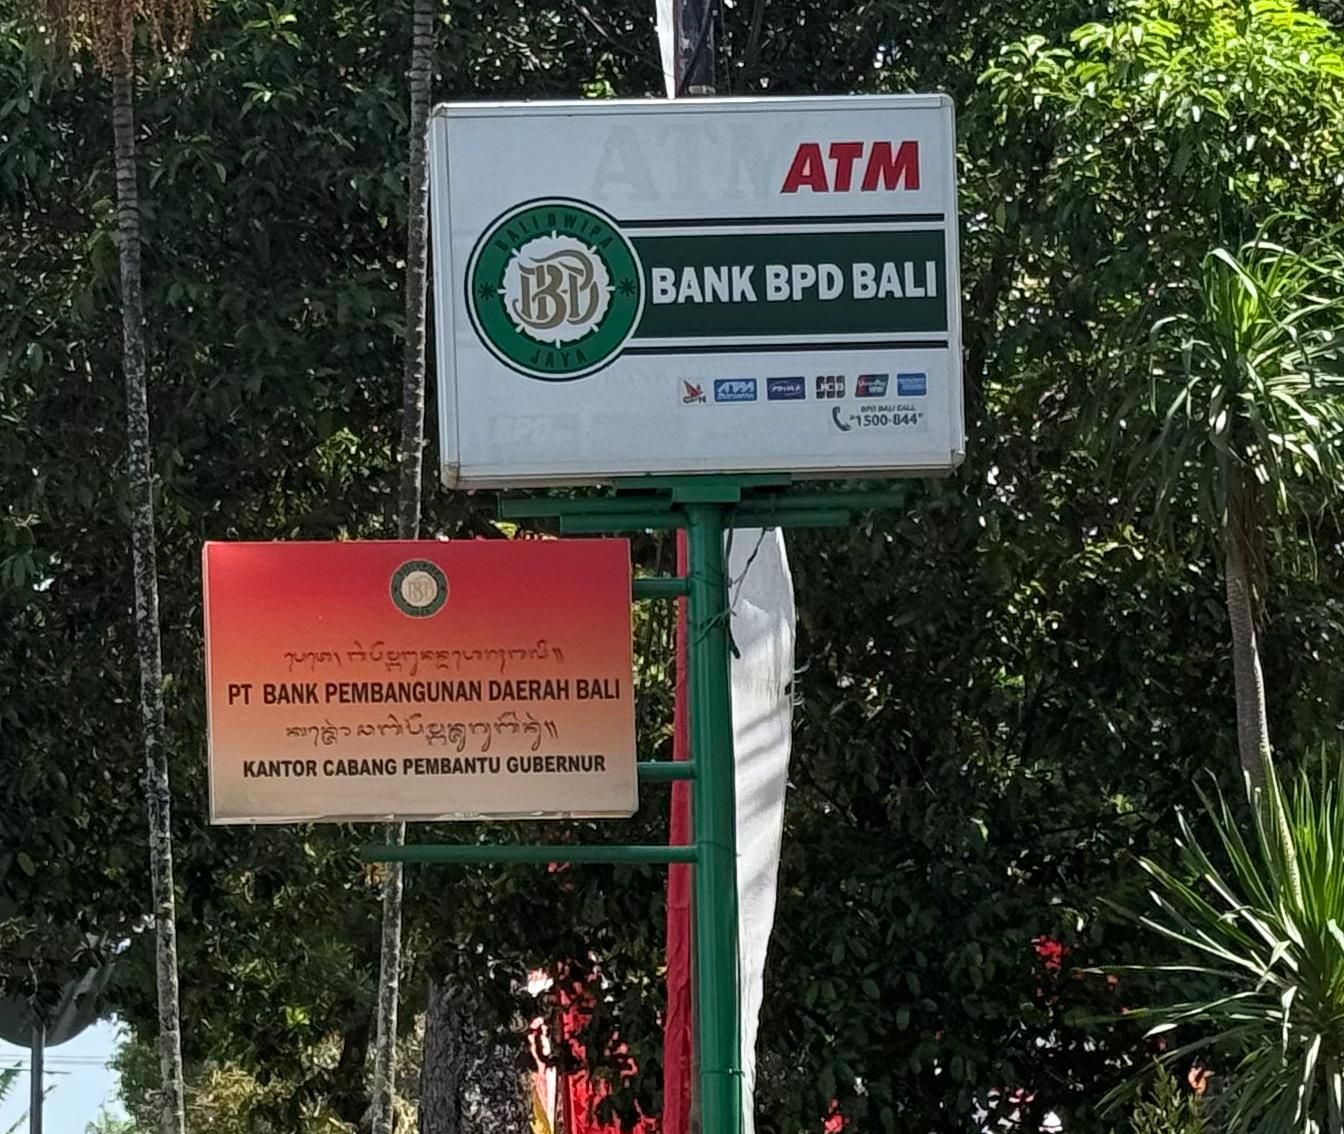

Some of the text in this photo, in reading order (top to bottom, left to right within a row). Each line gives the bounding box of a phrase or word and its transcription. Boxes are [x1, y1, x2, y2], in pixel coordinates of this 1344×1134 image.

[780, 140, 921, 194] ATM
[651, 259, 938, 305] BANK BPD BALI
[228, 677, 621, 706] PT BANK PEMBANGUNAN DAERAH BALI
[243, 754, 607, 779] KANTOR CABANG PEMBANTU GUBERNUR
